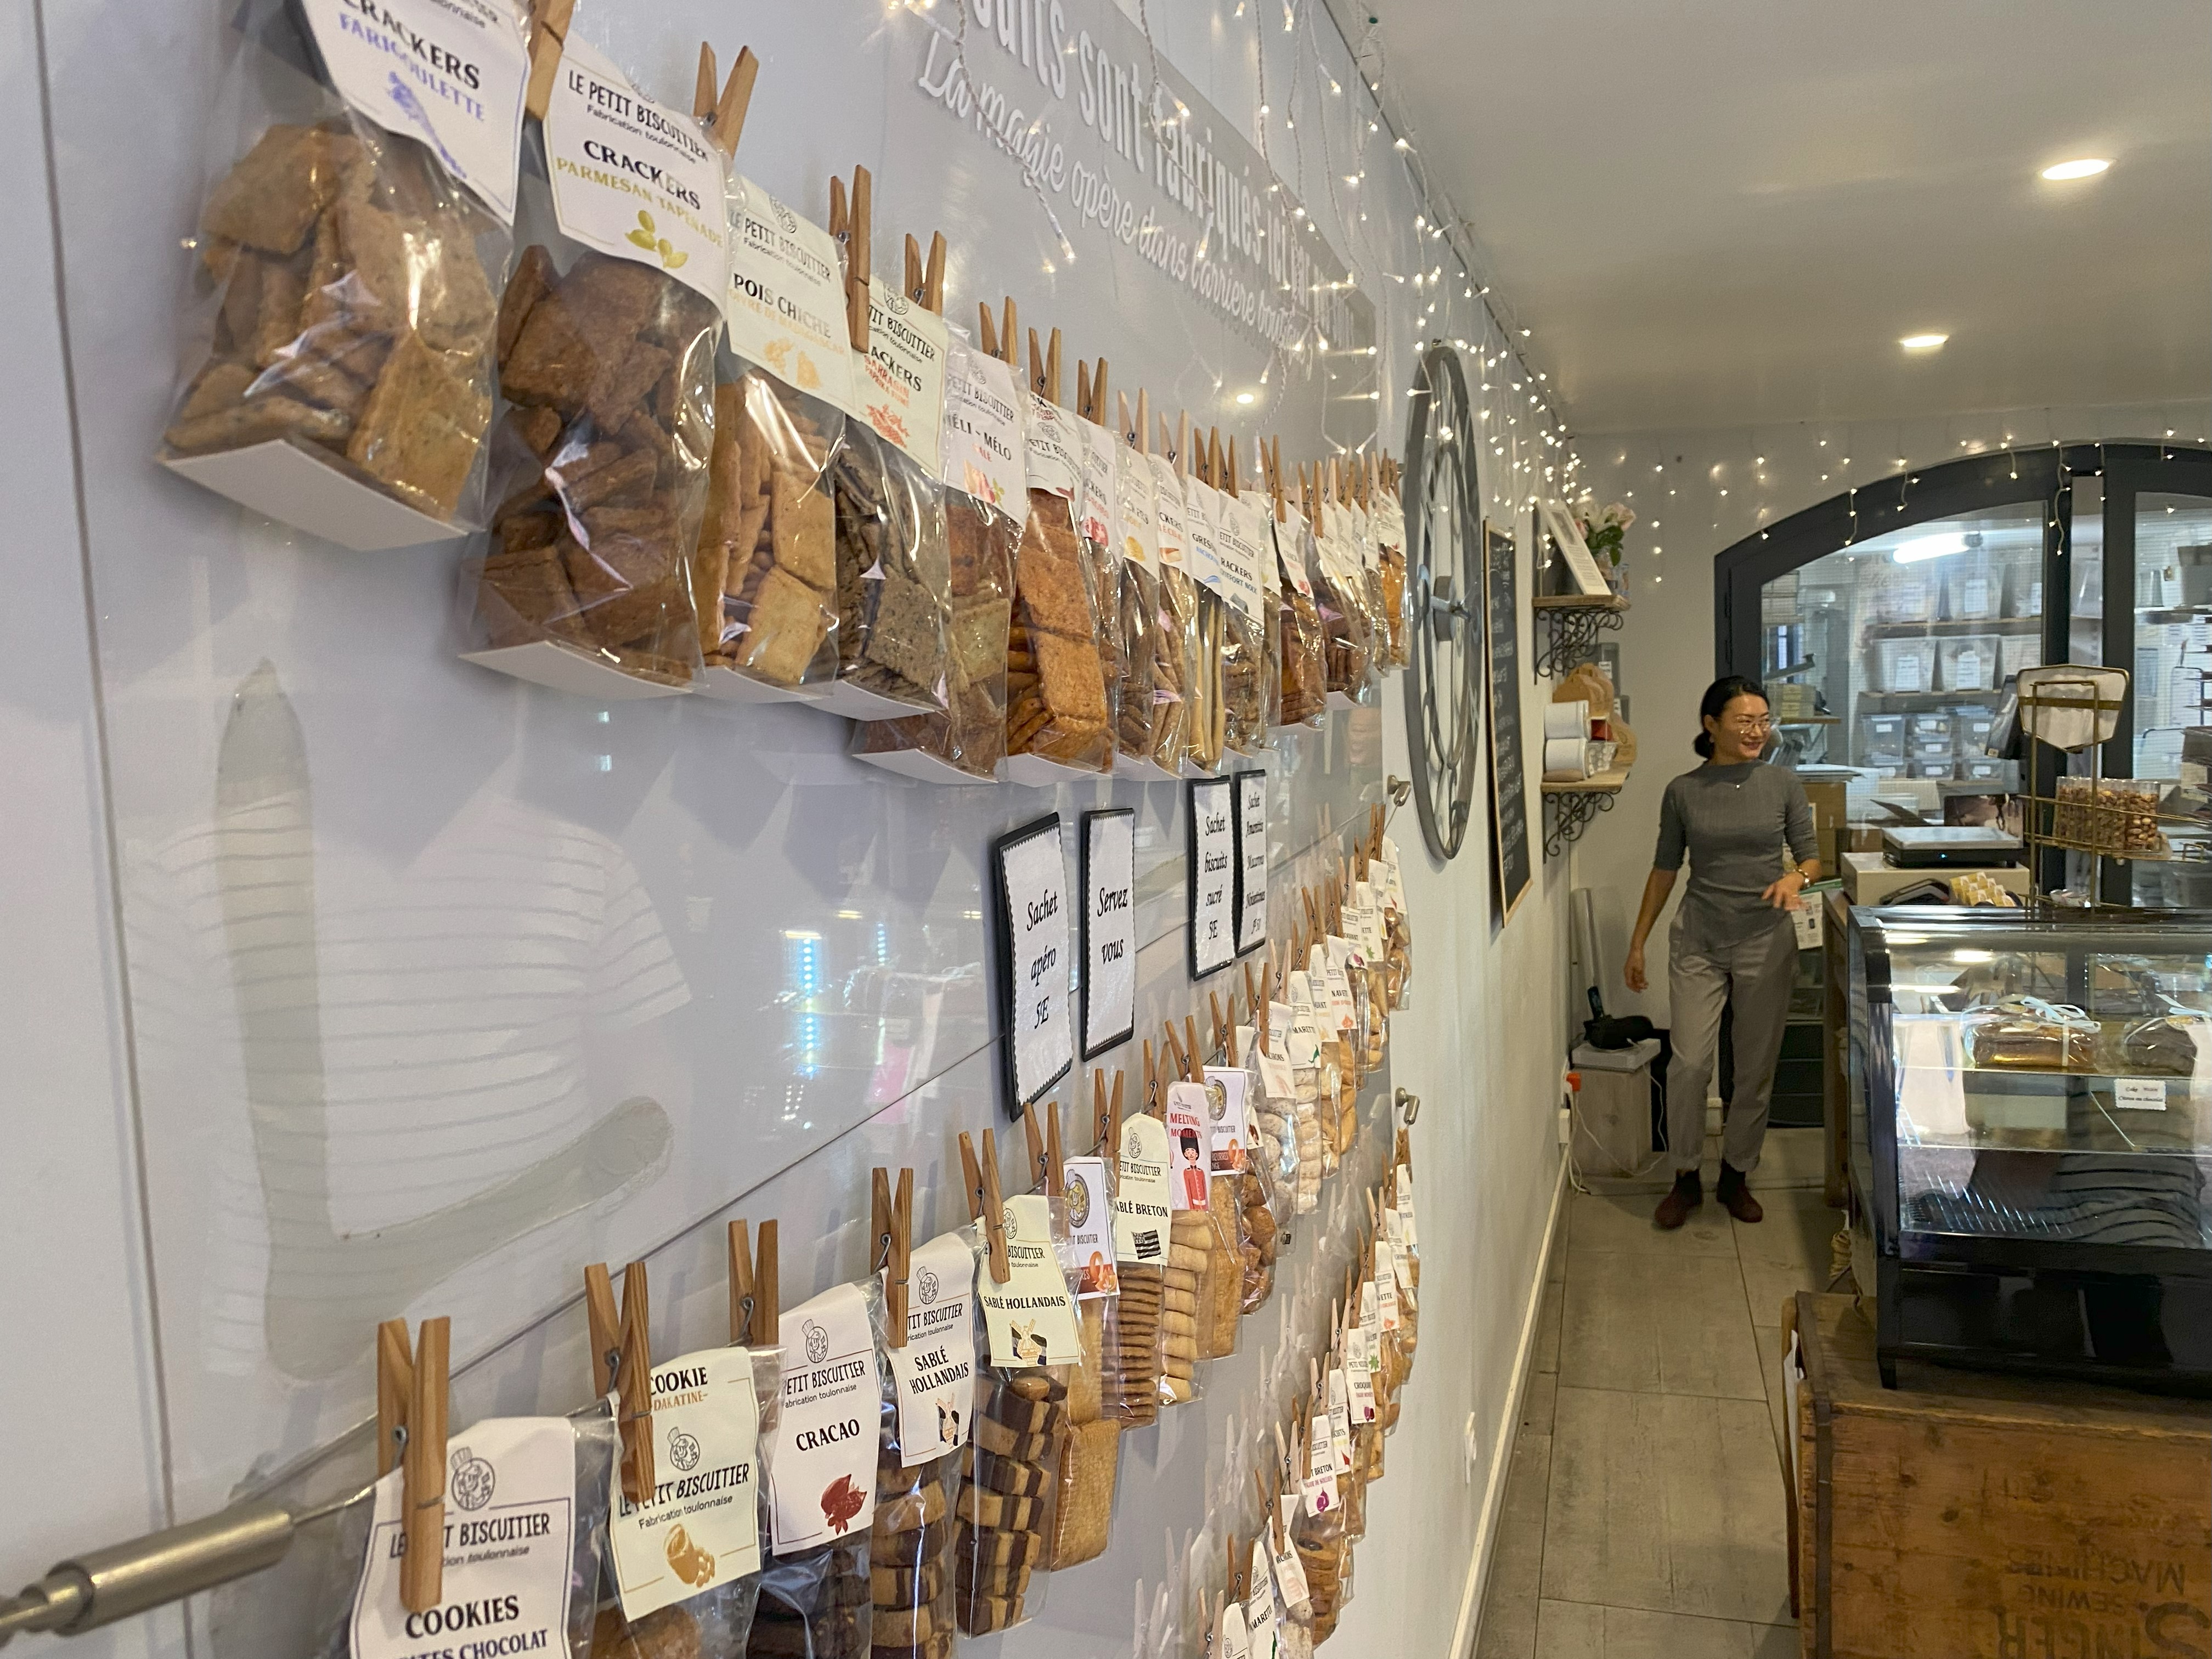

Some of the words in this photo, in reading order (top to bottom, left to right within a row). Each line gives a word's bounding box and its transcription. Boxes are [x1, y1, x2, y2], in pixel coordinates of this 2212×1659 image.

[568, 70, 584, 95] LE
[589, 81, 632, 117] PETIT
[636, 104, 709, 162] BISCUITIER
[1079, 30, 1145, 173] sont
[586, 104, 642, 136] Fabrication
[918, 31, 973, 119] La
[976, 83, 1066, 193] magie
[1139, 206, 1189, 281] dans
[556, 157, 653, 202] PARMESAN
[584, 140, 701, 210] CRACKERS
[744, 218, 775, 247] PETIT
[733, 273, 774, 306] POIS
[777, 296, 831, 339] CHICHE
[869, 304, 884, 326] TIT
[887, 317, 935, 362] BISCUITIER
[871, 346, 922, 392] ACKERS
[974, 387, 1015, 423] BISCUITIER
[984, 431, 1012, 461] MÉLO
[1029, 439, 1051, 452] ETIT
[1159, 512, 1183, 532] CKERS
[1187, 507, 1200, 519] ETIT
[1220, 532, 1232, 543] ETIT
[1221, 557, 1253, 582] RACKERS
[1205, 812, 1226, 836] Sachet
[1204, 850, 1228, 873] biscuits
[1026, 888, 1058, 932] Sachet
[1097, 885, 1128, 918] Servez
[1205, 884, 1223, 907] sucré
[1101, 937, 1125, 966] vous
[1031, 945, 1057, 988] apéro
[1293, 1026, 1316, 1035] MARETTI
[1170, 1113, 1200, 1127] MELTING
[1171, 1128, 1203, 1139] MOMENTS
[1120, 1160, 1130, 1172] TIT
[1131, 1163, 1161, 1177] BISCUITIER
[1116, 1200, 1134, 1214] BLÉ
[1135, 1203, 1169, 1218] BRETON
[1008, 1245, 1046, 1260] BISCUITIER
[984, 1296, 1005, 1310] SABLÉ
[1005, 1296, 1066, 1310] HOLLANDAIS
[1379, 1292, 1393, 1301] ETTE
[907, 1313, 922, 1330] TIT
[923, 1303, 963, 1327] BISCUITIER
[907, 1331, 927, 1342] rication
[928, 1323, 953, 1336] toulonnaise
[914, 1345, 949, 1372] SABLÉ
[812, 1360, 866, 1389] BISCUITIER
[909, 1362, 969, 1395] HOLLANDAIS
[1353, 1381, 1372, 1390] CROQU
[783, 1394, 817, 1408] abrication
[819, 1384, 857, 1400] toulonnaise
[796, 1419, 860, 1452] CRACAO
[1315, 1463, 1333, 1476] BRETON
[636, 1481, 674, 1512] TIT
[676, 1463, 750, 1499] BISCUITIER
[638, 1505, 683, 1531] Fabrication
[684, 1495, 733, 1514] toulonnaise
[459, 1512, 551, 1547] BISCUITIER
[467, 1545, 530, 1564] toulonnaise
[405, 1594, 520, 1639] COOKIES
[459, 1628, 548, 1659] CHOCOLAT
